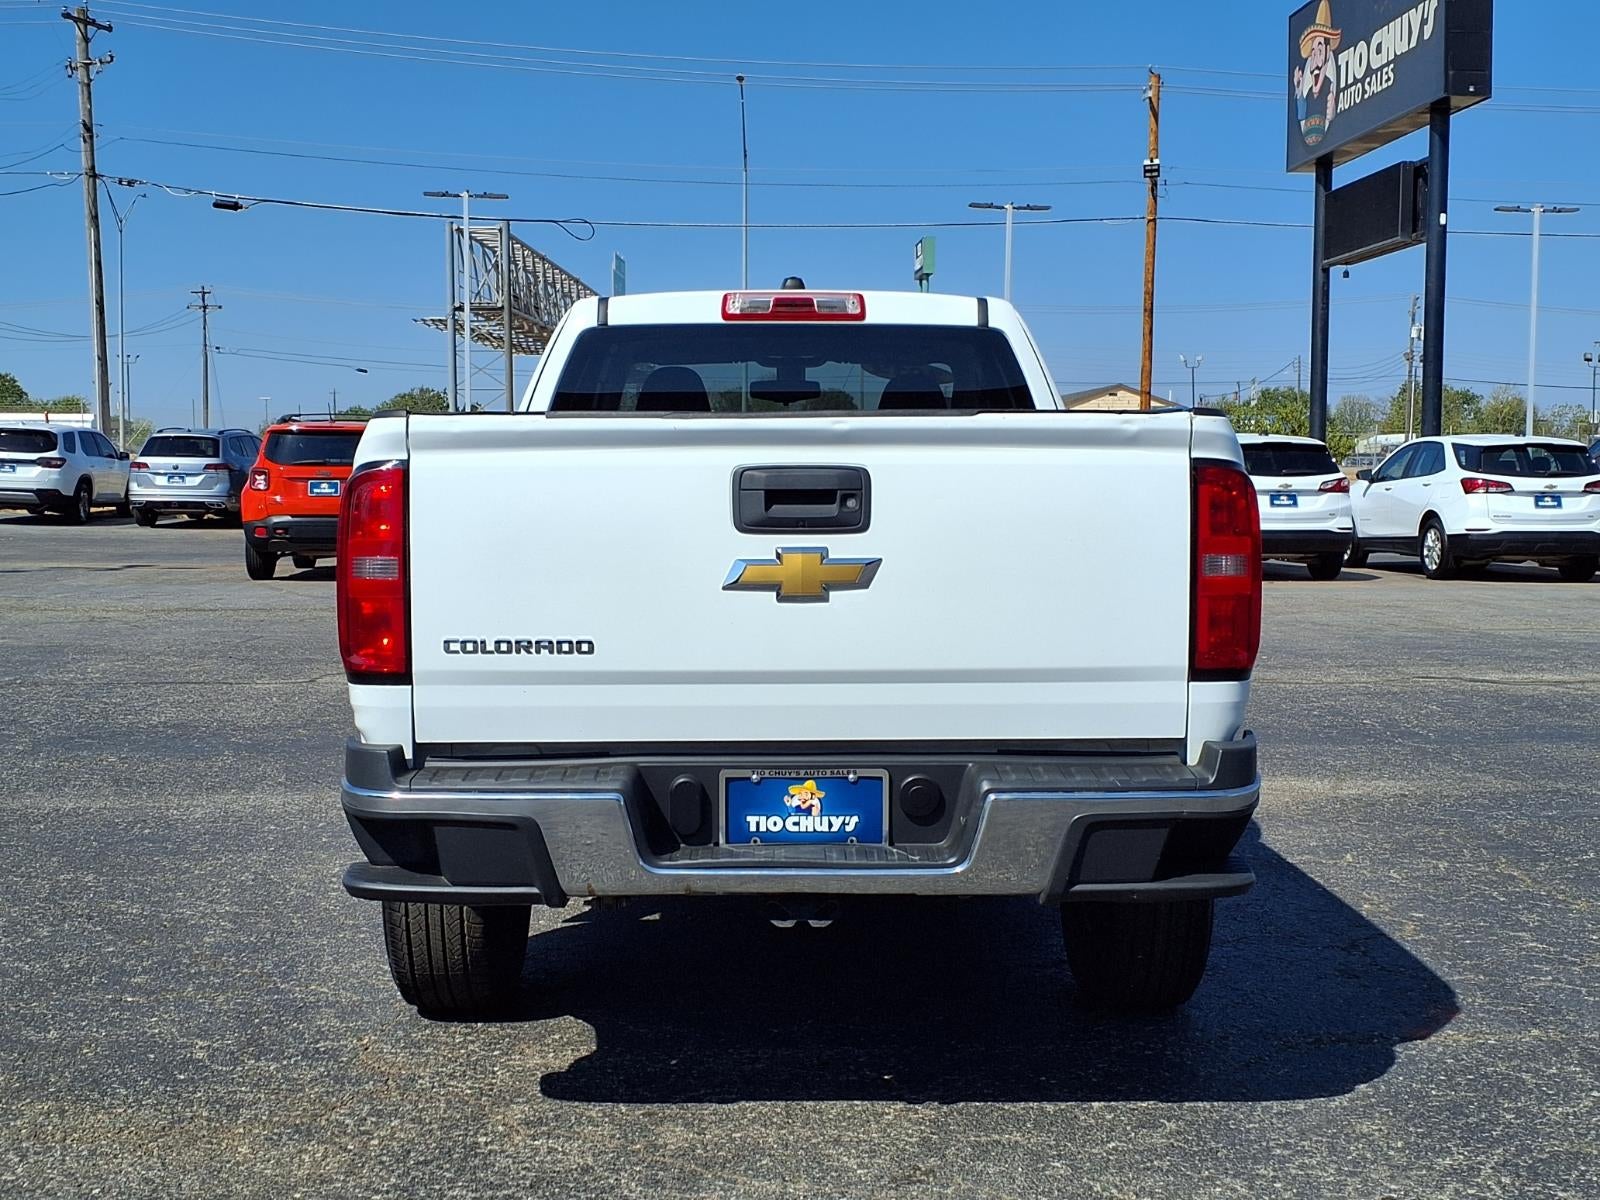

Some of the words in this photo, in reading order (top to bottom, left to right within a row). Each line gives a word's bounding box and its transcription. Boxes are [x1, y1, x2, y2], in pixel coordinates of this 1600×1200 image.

[1338, 40, 1369, 88] TIO
[1369, 0, 1438, 70] CHUY'S
[1337, 86, 1362, 113] AUTO
[1364, 63, 1395, 96] SALES
[443, 639, 595, 655] COLORADO
[768, 769, 801, 777] CHUY'S
[803, 769, 827, 777] AUTO
[829, 769, 858, 777] SALES
[746, 815, 783, 832] TIO
[784, 815, 859, 833] CHUY'S
